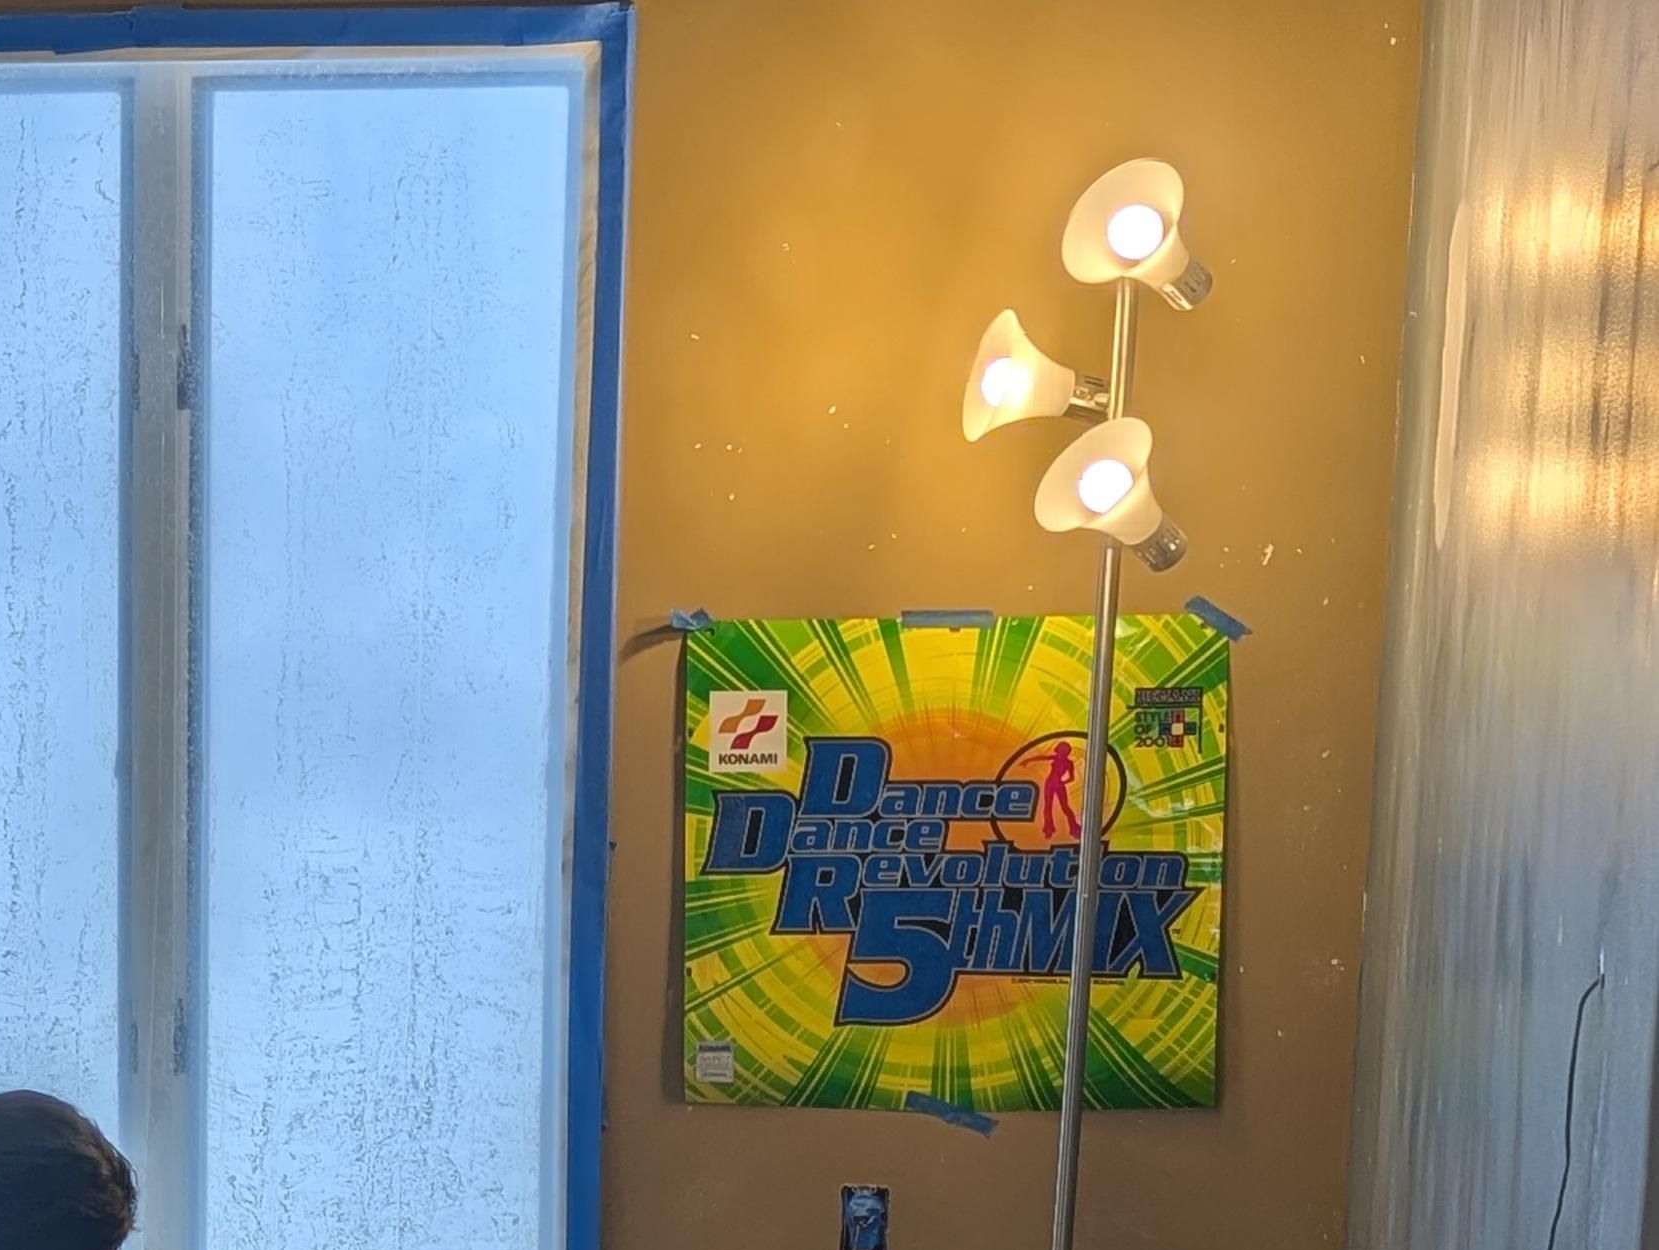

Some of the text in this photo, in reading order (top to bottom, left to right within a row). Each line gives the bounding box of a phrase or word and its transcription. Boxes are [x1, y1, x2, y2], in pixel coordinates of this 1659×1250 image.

[718, 752, 778, 766] KONAMI
[800, 736, 1039, 822] Dance
[701, 790, 948, 876] Dance
[770, 840, 1190, 936] Revoluton
